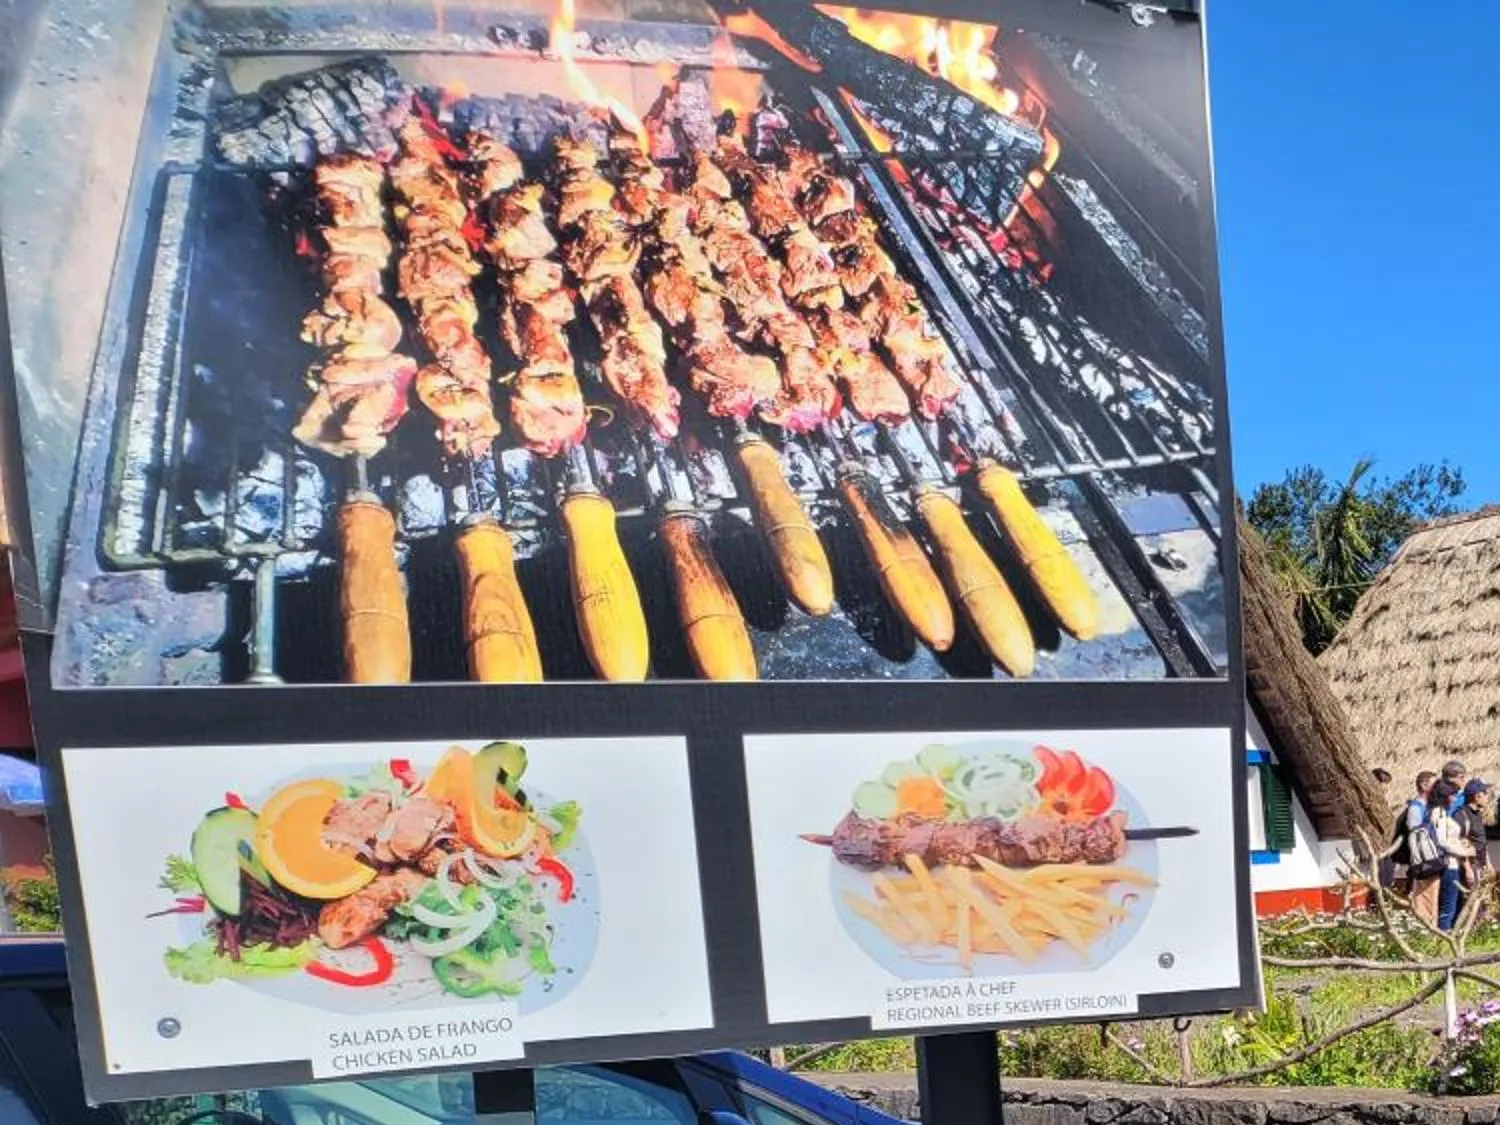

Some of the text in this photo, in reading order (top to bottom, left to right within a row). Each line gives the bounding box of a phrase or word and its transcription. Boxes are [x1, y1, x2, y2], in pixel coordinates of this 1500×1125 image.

[886, 985, 961, 1002] ESPETADA
[979, 980, 1018, 997] CHEF
[887, 1005, 960, 1022] REGIONAL
[967, 1000, 1001, 1017] BEEF
[1005, 998, 1061, 1015] SKEWER
[329, 1016, 513, 1049] SALADA DE FRANGO
[332, 1042, 477, 1071] CHICKEN SALAD
